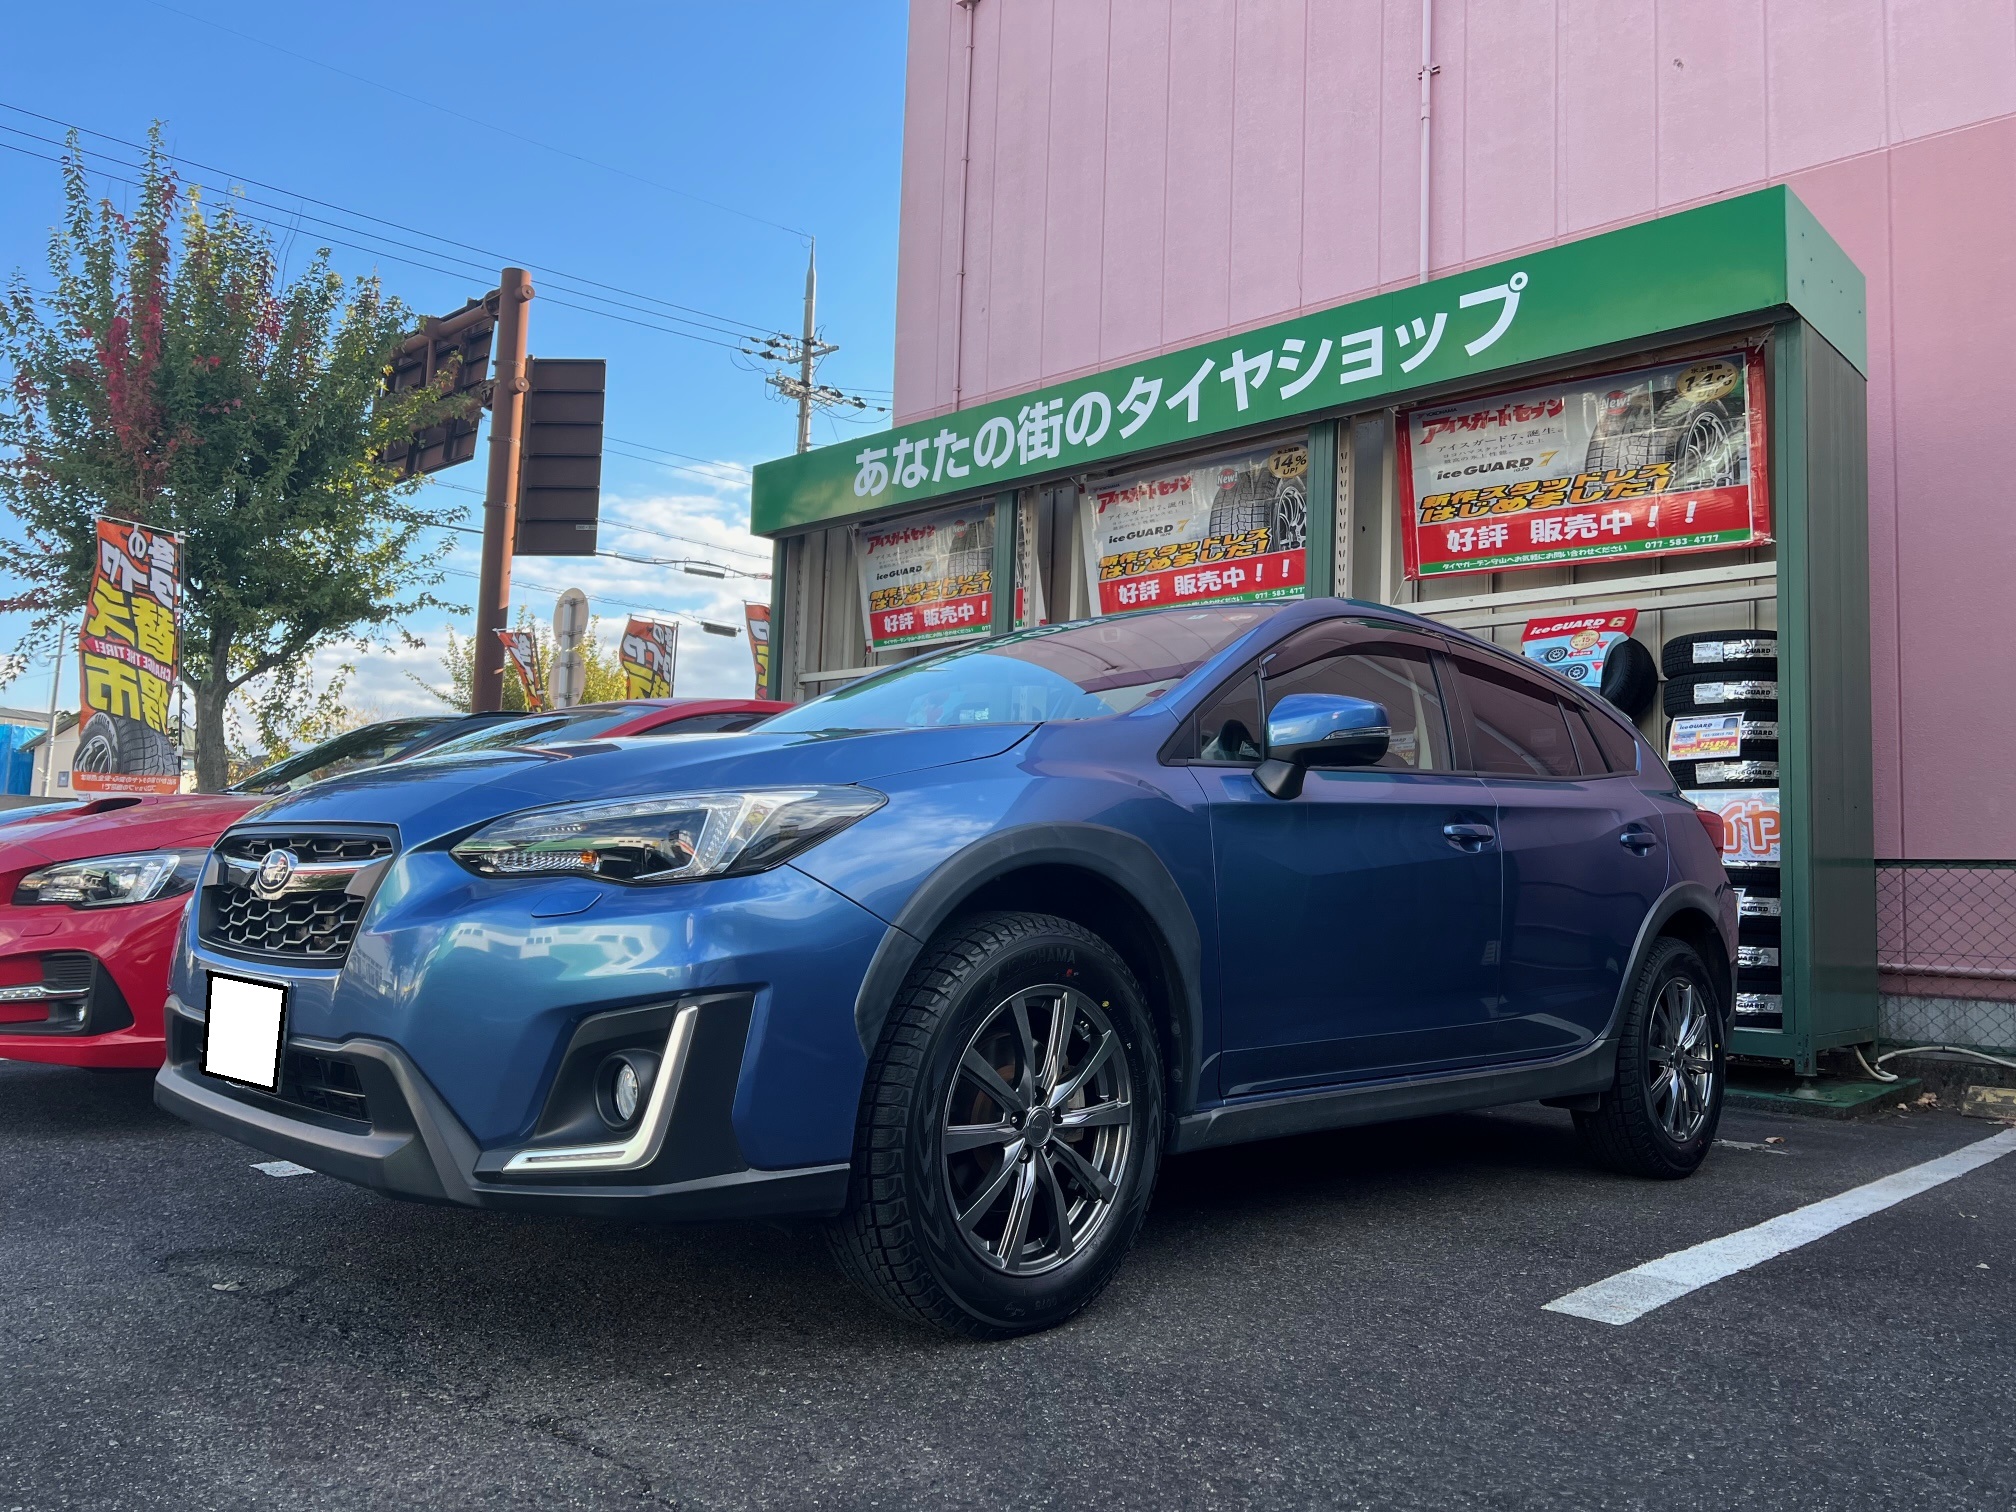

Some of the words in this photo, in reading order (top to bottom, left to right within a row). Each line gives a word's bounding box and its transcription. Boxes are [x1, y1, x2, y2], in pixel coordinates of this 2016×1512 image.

[854, 271, 1529, 499] あなたの街のタイヤショップ
[1600, 394, 1632, 410] New!
[1425, 407, 1458, 417] YOKOHAMA
[1419, 398, 1566, 446] アイスガードセブン
[1273, 453, 1308, 471] 14%
[1282, 467, 1299, 476] UP!
[1437, 456, 1535, 481] iceGUARD
[1537, 450, 1560, 467] 7
[1216, 471, 1239, 485] New!
[1420, 461, 1675, 511] 新作スタッドレス
[1419, 475, 1672, 525] はじめました!
[1108, 524, 1174, 544] iceGUARD
[1176, 518, 1190, 534] 7
[1446, 524, 1509, 553] 好評
[1644, 534, 1720, 549] 077-583-4777
[1118, 579, 1161, 605] 好評
[1255, 586, 1306, 600] 077-583-477
[883, 614, 915, 633] 好評
[1529, 618, 1606, 636] iceGUARD
